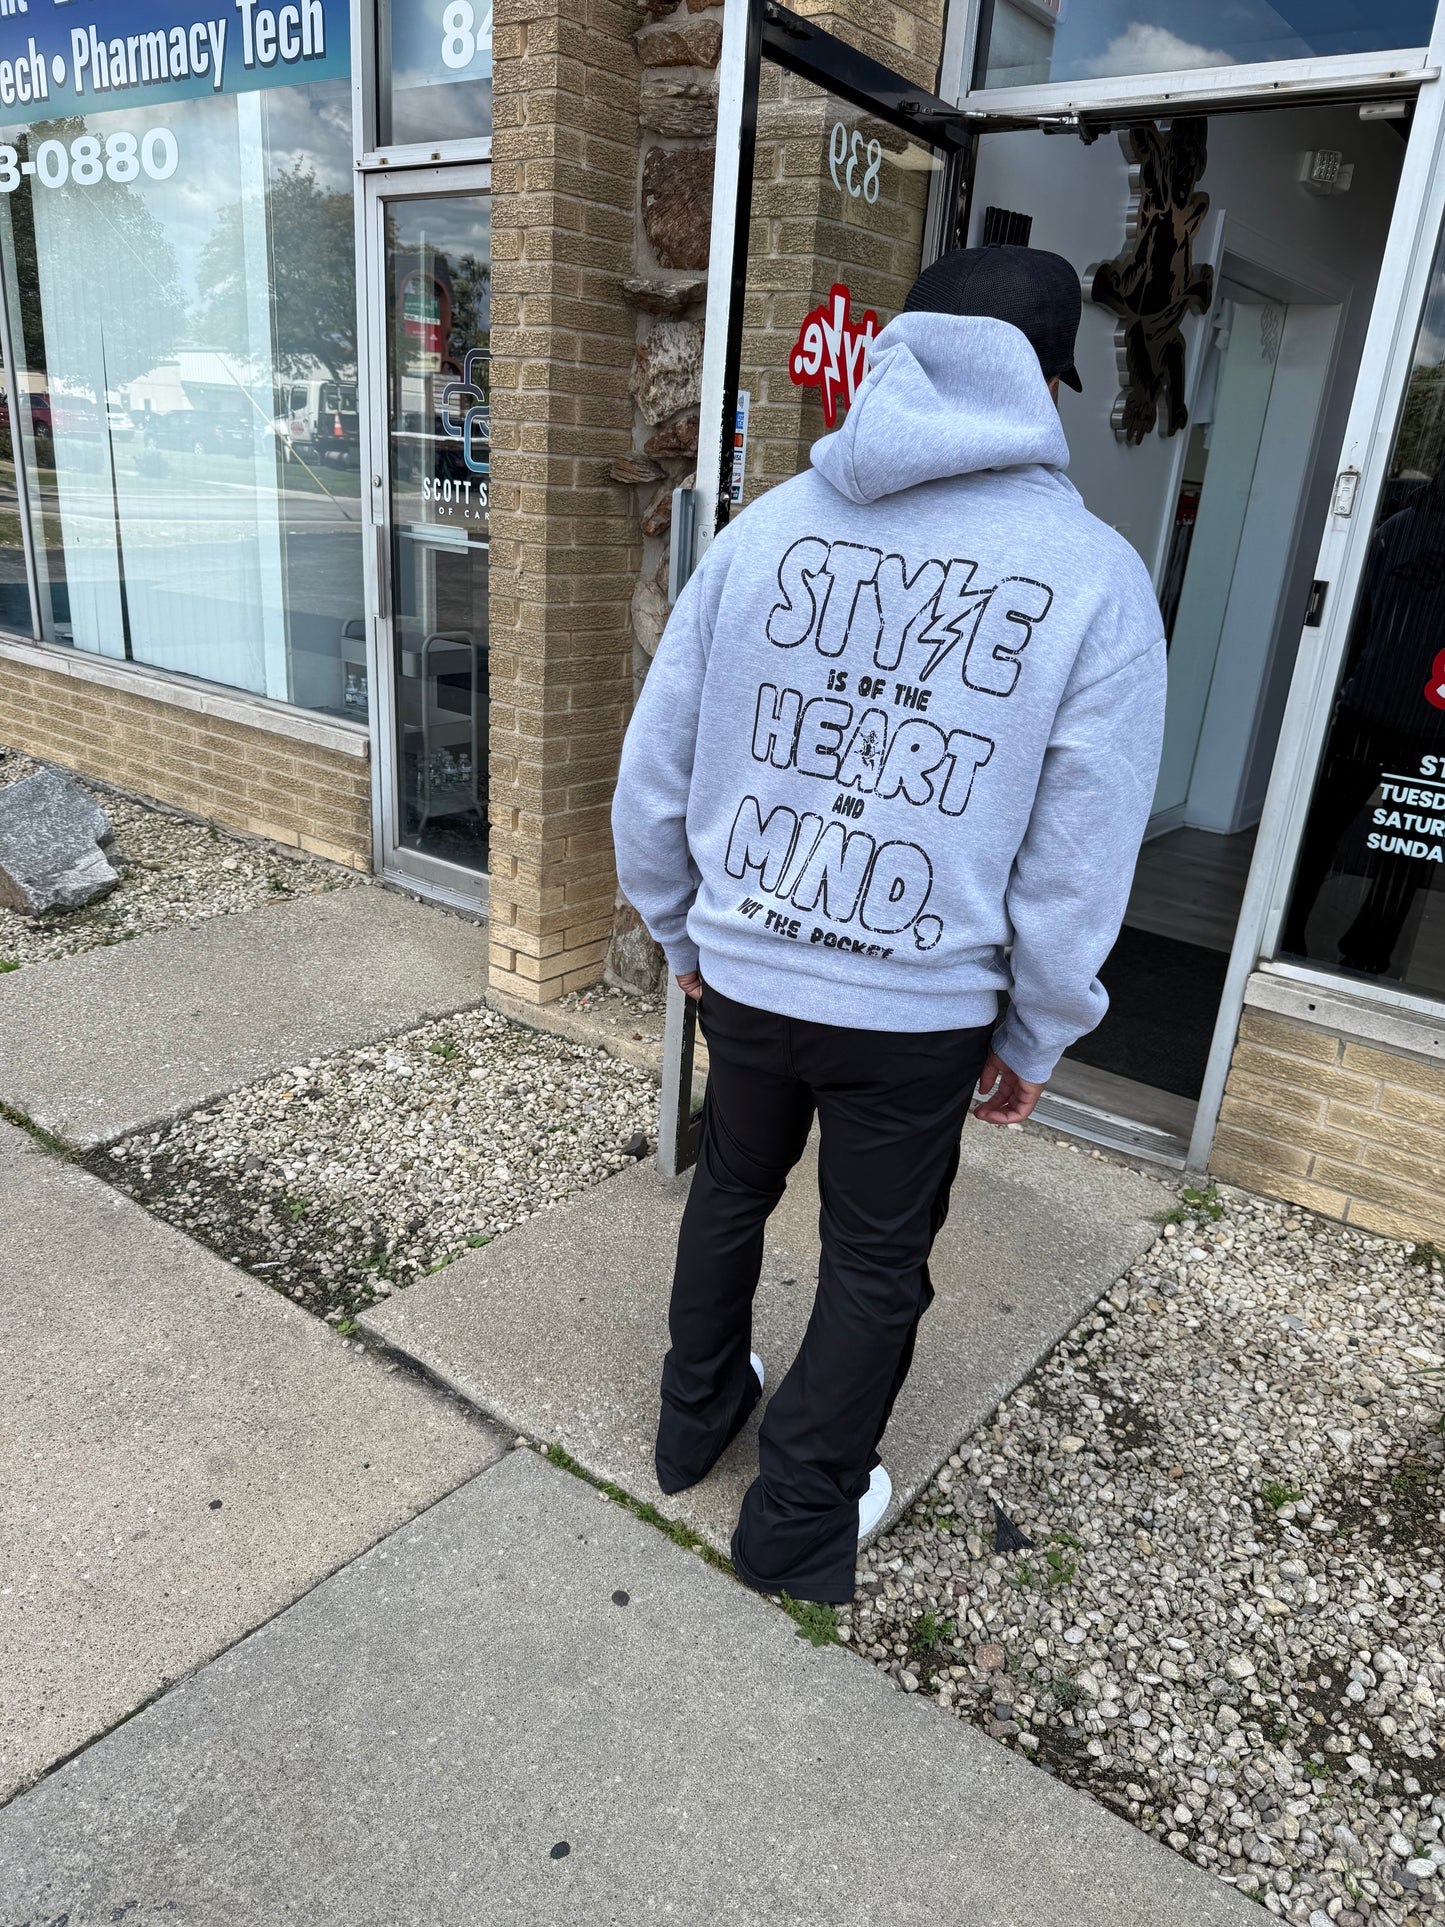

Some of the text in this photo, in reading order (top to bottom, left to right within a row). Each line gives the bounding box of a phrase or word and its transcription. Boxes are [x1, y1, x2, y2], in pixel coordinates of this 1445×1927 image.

[70, 18, 227, 92] Pharmacy
[236, 0, 324, 65] Tech
[423, 476, 472, 505] SCOTT
[438, 506, 454, 516] OF
[766, 536, 1054, 697] STYLE
[858, 675, 887, 700] OF
[894, 682, 933, 712] THE
[751, 682, 995, 816] HEART
[832, 793, 865, 819] AND
[1380, 782, 1445, 811] TUESD
[1366, 832, 1444, 864] SUNDA
[763, 909, 802, 939] THE
[809, 926, 895, 960] POCKET
